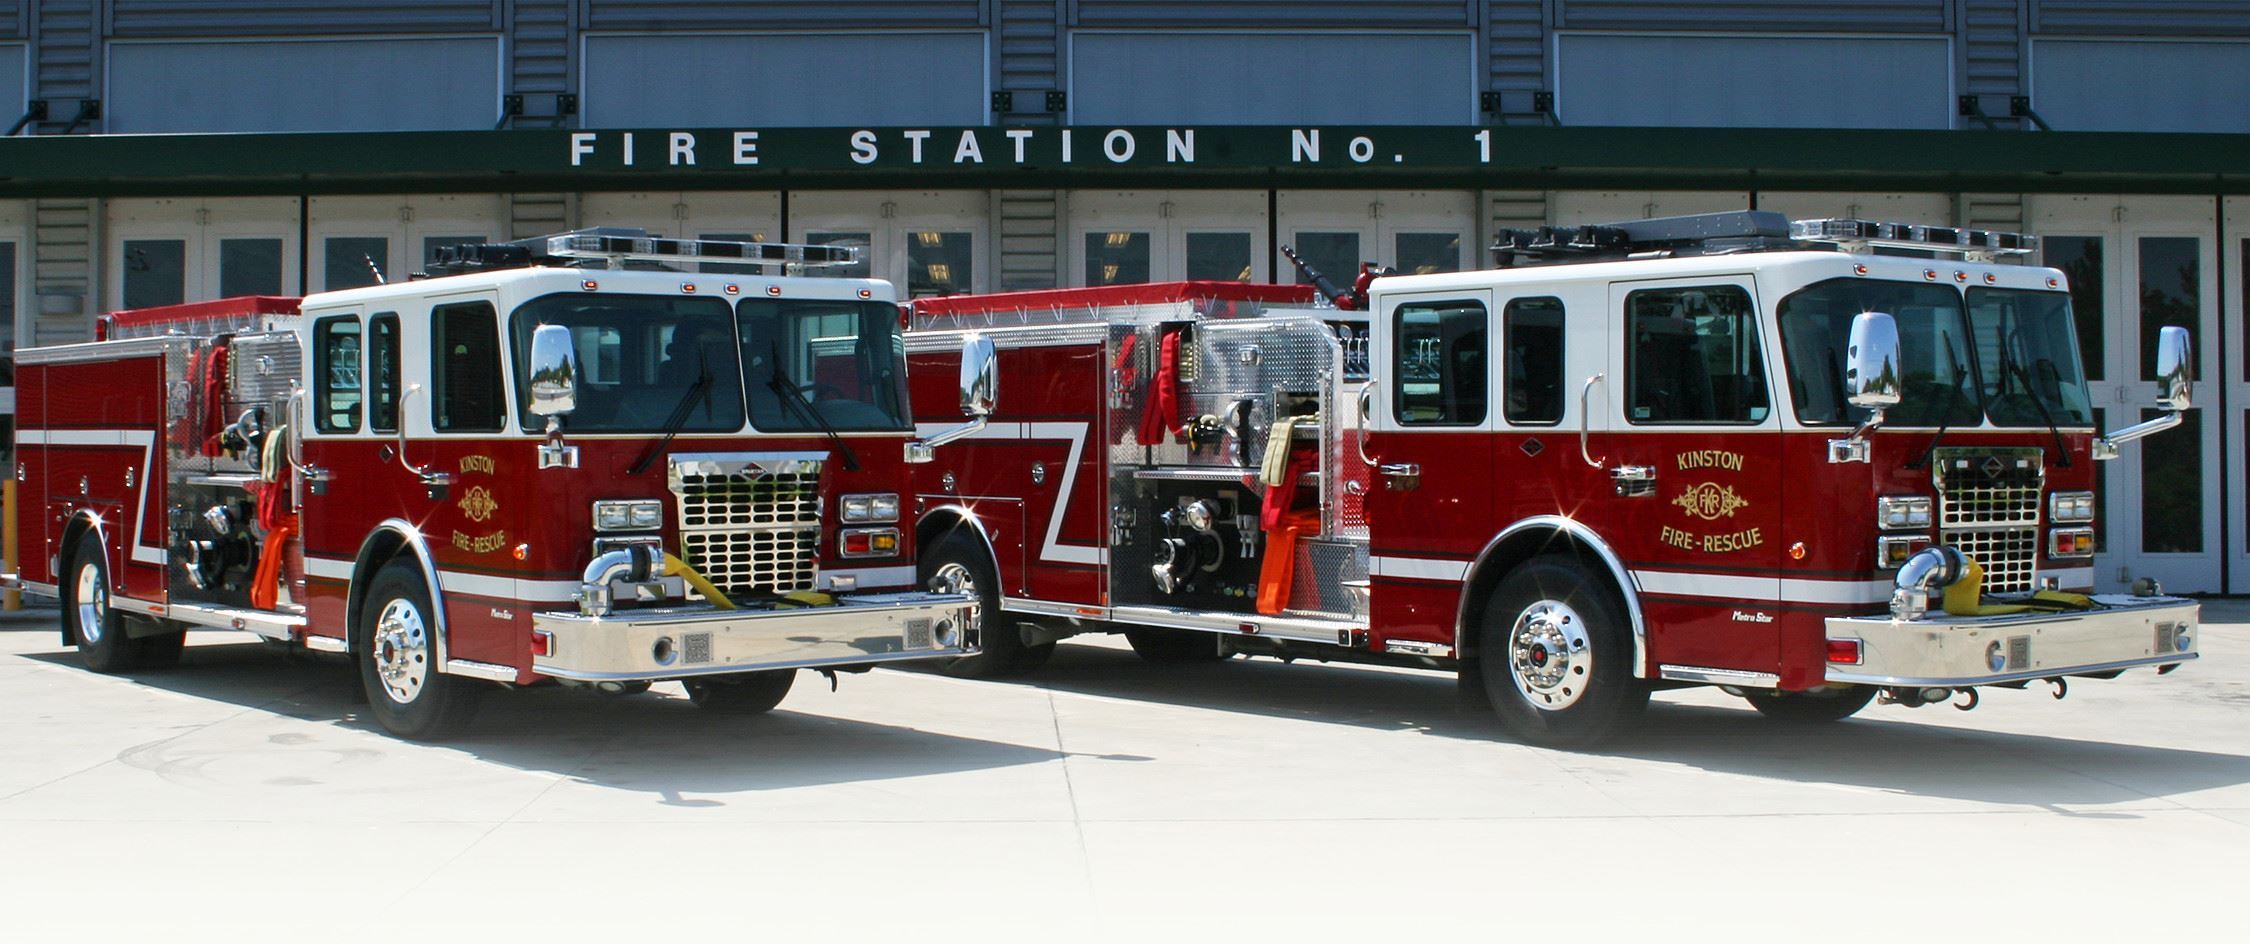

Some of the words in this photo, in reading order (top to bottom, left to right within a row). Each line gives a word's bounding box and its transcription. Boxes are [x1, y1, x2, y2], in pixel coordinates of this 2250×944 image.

[570, 131, 759, 166] FIRE
[850, 129, 1195, 164] STATION
[1291, 129, 1403, 163] No.
[1474, 129, 1490, 163] 1
[459, 455, 495, 476] KINSTON
[1677, 450, 1744, 472] KINSTON
